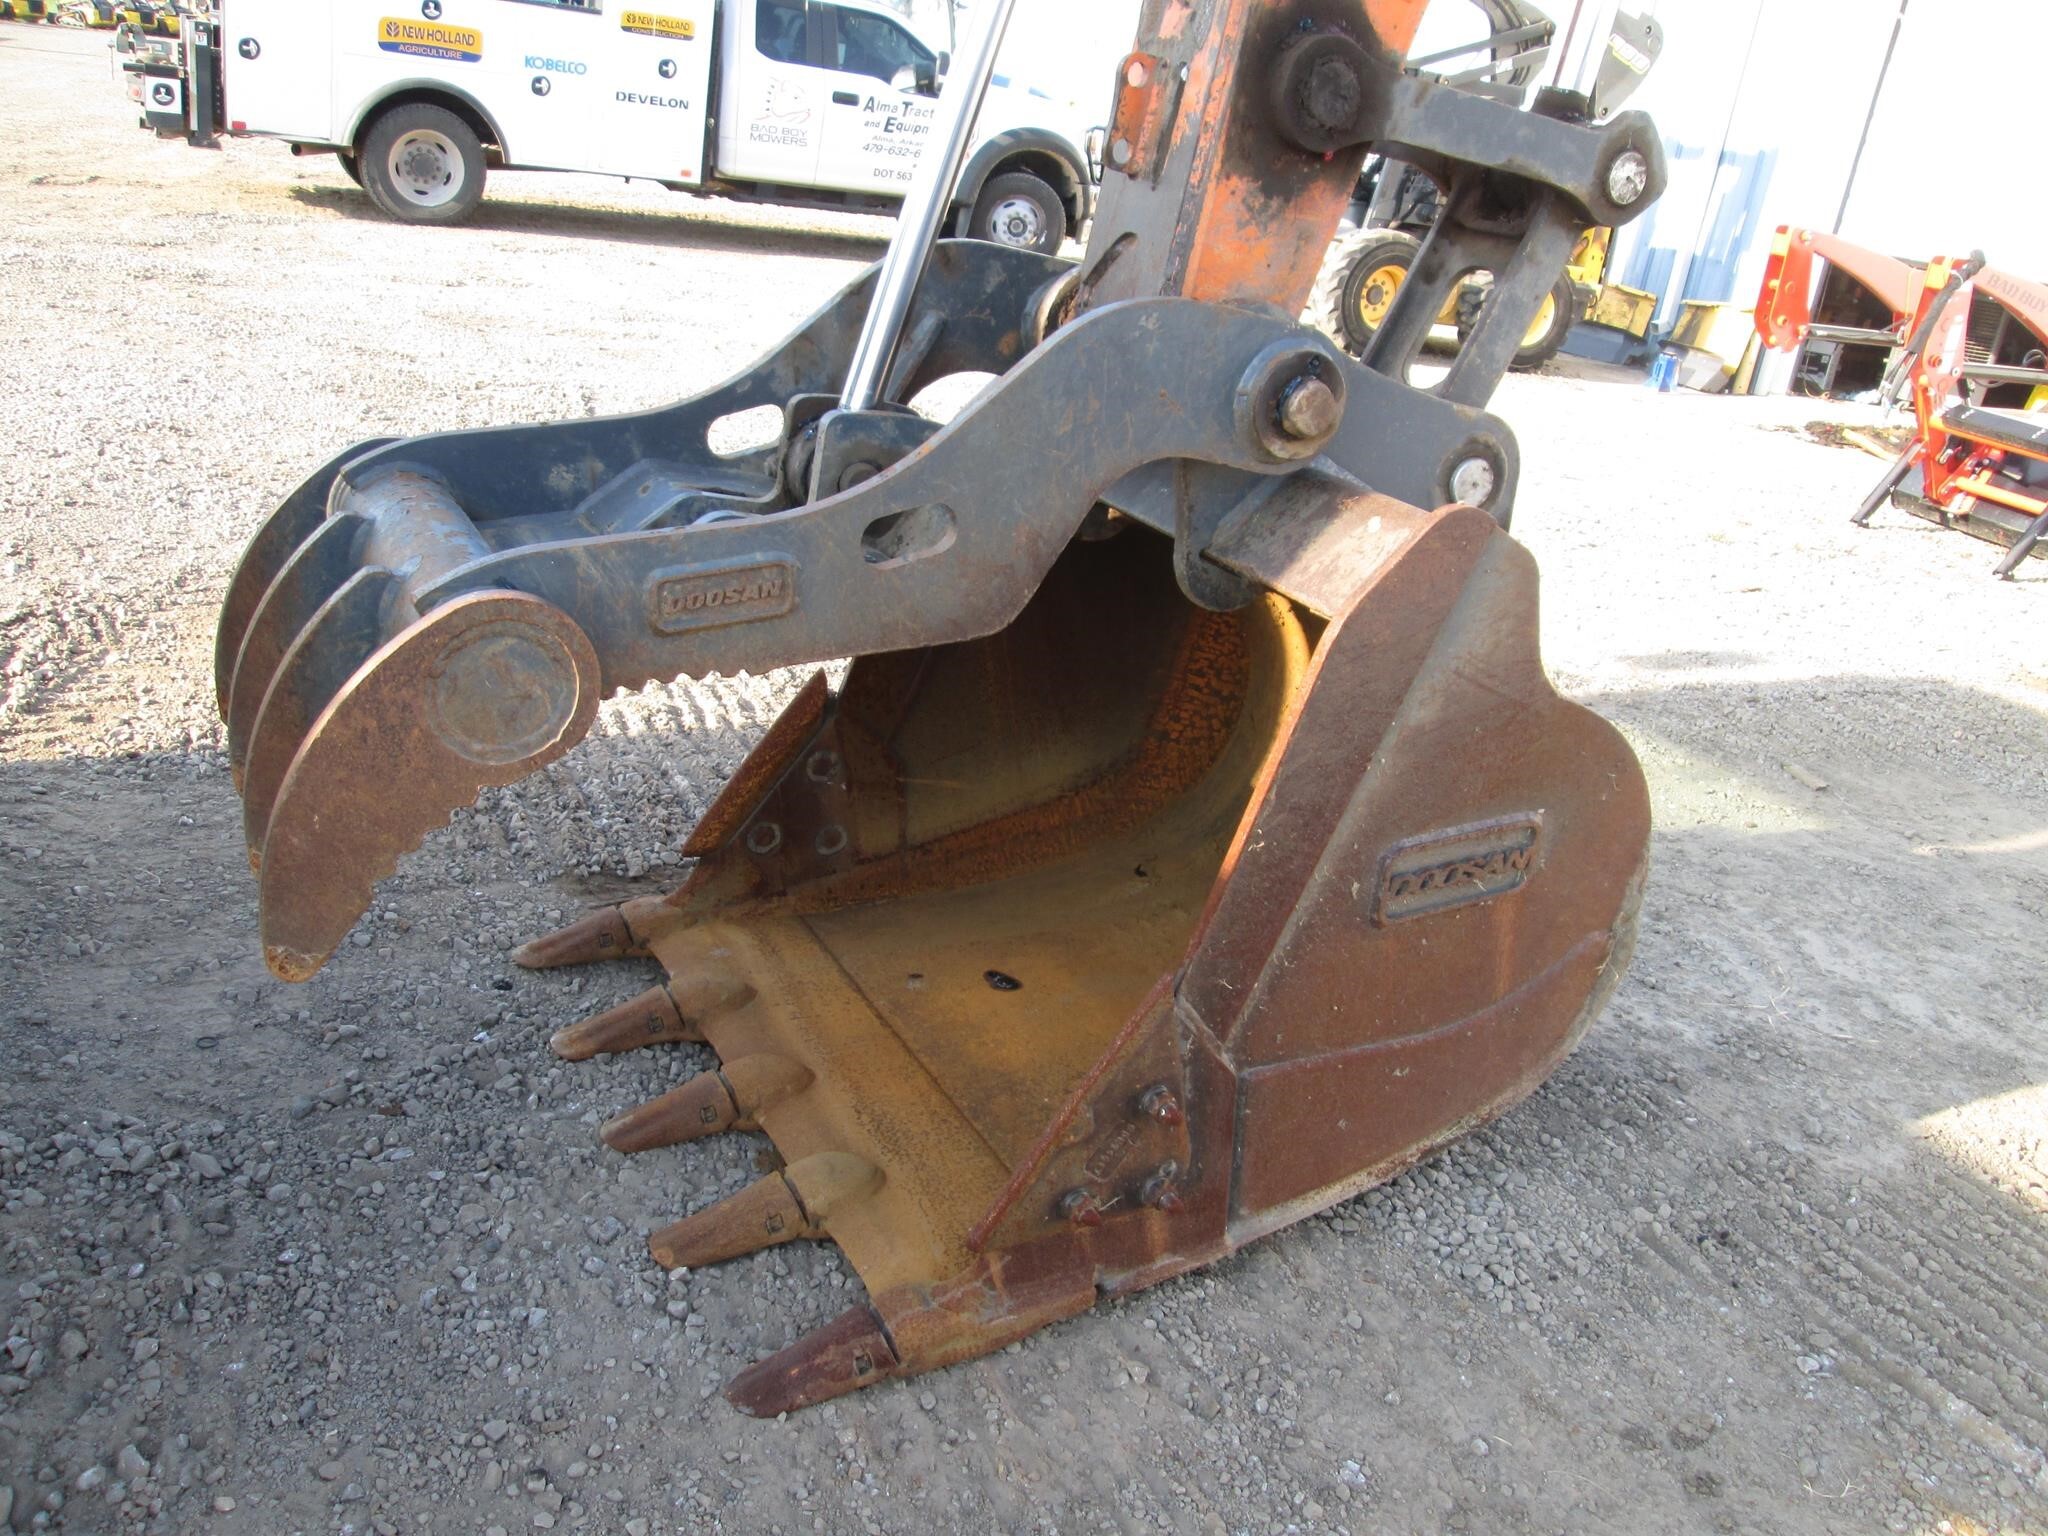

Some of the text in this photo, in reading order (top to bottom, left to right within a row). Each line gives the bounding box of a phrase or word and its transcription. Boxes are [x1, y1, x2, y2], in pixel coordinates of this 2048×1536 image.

[638, 15, 691, 32] NEW HOLLAND
[402, 24, 475, 47] NEW HOLLAND
[398, 43, 464, 60] AGRICULTURE
[524, 55, 587, 76] KOBELCO
[615, 91, 690, 110] DEVELON
[863, 95, 935, 119] Alma Tract
[750, 123, 808, 138] BAD BOY
[864, 119, 881, 129] and
[750, 132, 808, 147] MOWERS
[873, 167, 894, 179] DOT
